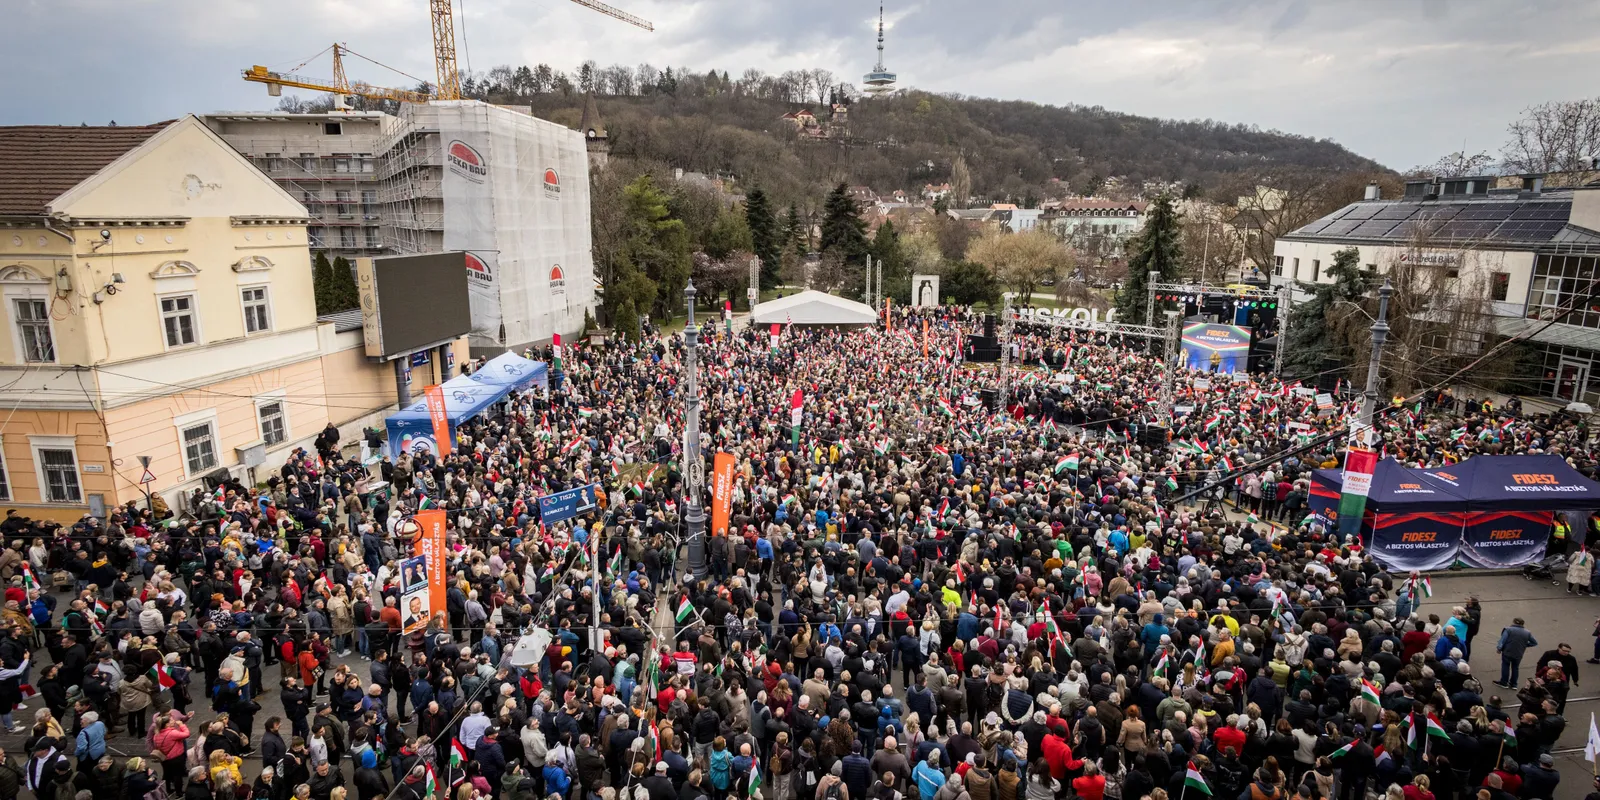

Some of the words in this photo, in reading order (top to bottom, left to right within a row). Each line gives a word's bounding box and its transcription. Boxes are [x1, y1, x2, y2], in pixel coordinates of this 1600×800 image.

[448, 154, 468, 170] PEKA
[469, 164, 486, 176] BAU
[475, 271, 492, 282] BAU
[1206, 329, 1230, 337] FIDESZ
[1348, 475, 1370, 483] FIDESZ
[1512, 474, 1559, 485] FIDESZ
[716, 473, 725, 501] FIDESZ
[1540, 484, 1588, 492] VÁLASZTÁS
[559, 492, 576, 502] TISZA
[432, 522, 440, 557] VÁLASZTÁS
[1402, 532, 1437, 542] FIDESZ
[1490, 529, 1523, 540] FIDESZ
[1414, 541, 1449, 549] VÁLASZTÁS
[422, 538, 433, 571] FIDESZ
